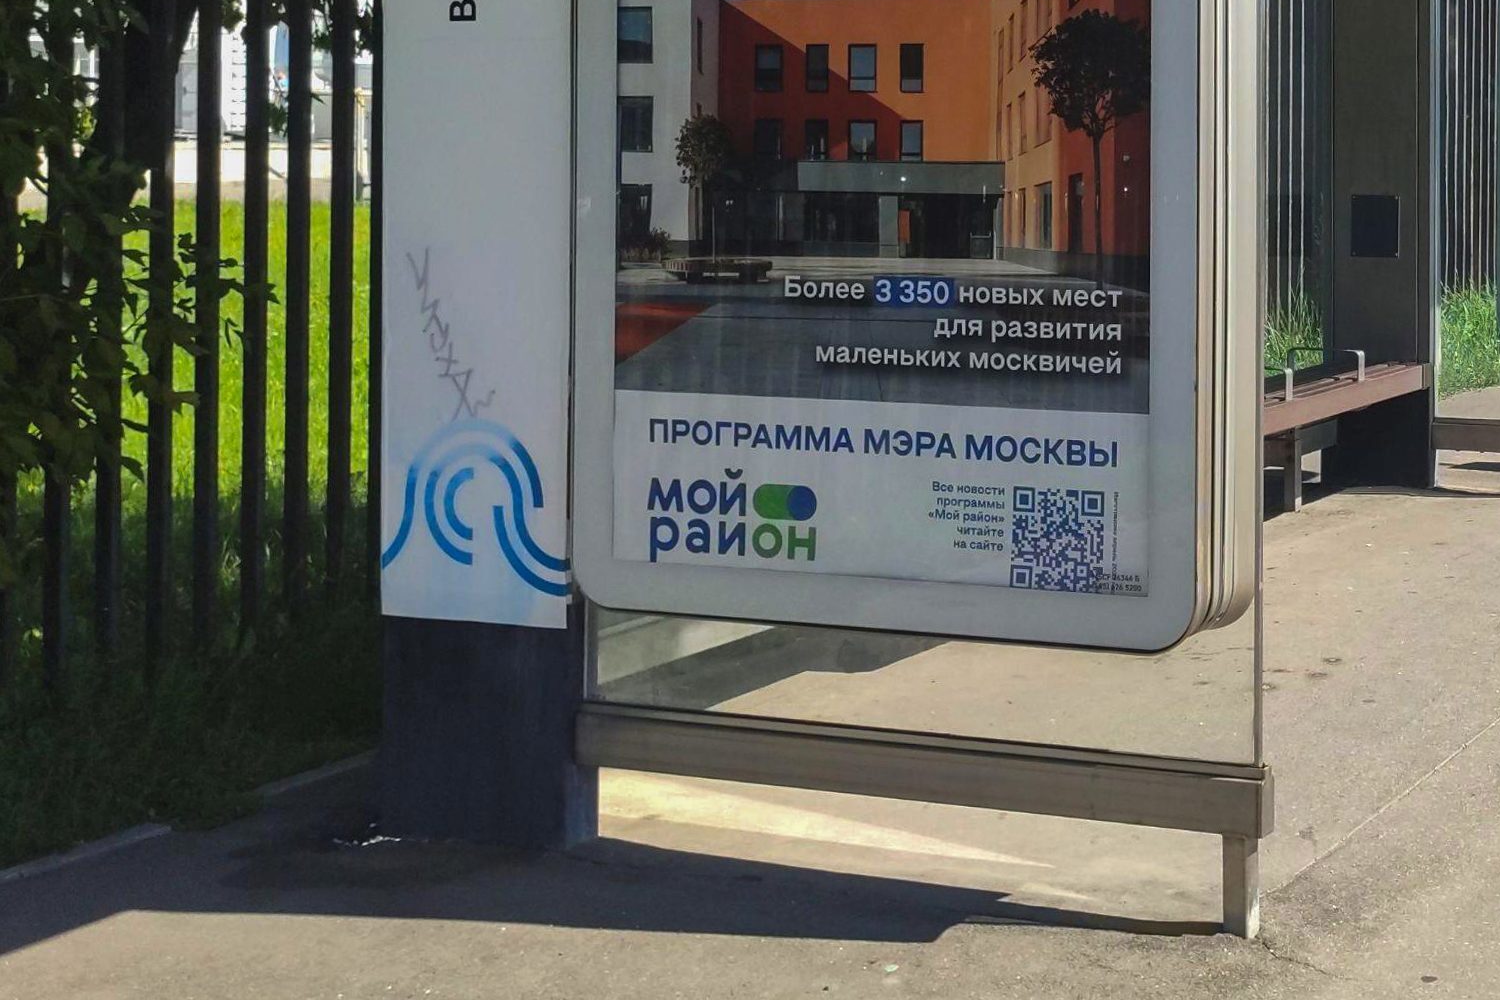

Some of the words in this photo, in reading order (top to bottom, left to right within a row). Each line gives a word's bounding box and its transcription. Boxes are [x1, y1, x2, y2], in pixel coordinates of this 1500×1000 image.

[784, 275, 865, 300] Более
[958, 286, 1045, 306] новых
[1052, 289, 1123, 308] мест
[933, 318, 983, 338] для
[991, 320, 1122, 343] развития
[815, 345, 961, 368] маленьких
[969, 350, 1122, 374] москвичей
[649, 418, 855, 454] ПРОГРАММА
[863, 428, 957, 460] МЭРА
[965, 433, 1119, 468] МОСКВЫ
[932, 481, 954, 493] Все
[957, 485, 1005, 497] новости
[937, 497, 1006, 512] программы
[956, 525, 1005, 538] читайте
[953, 538, 967, 549] на
[969, 539, 1004, 552] сайте
